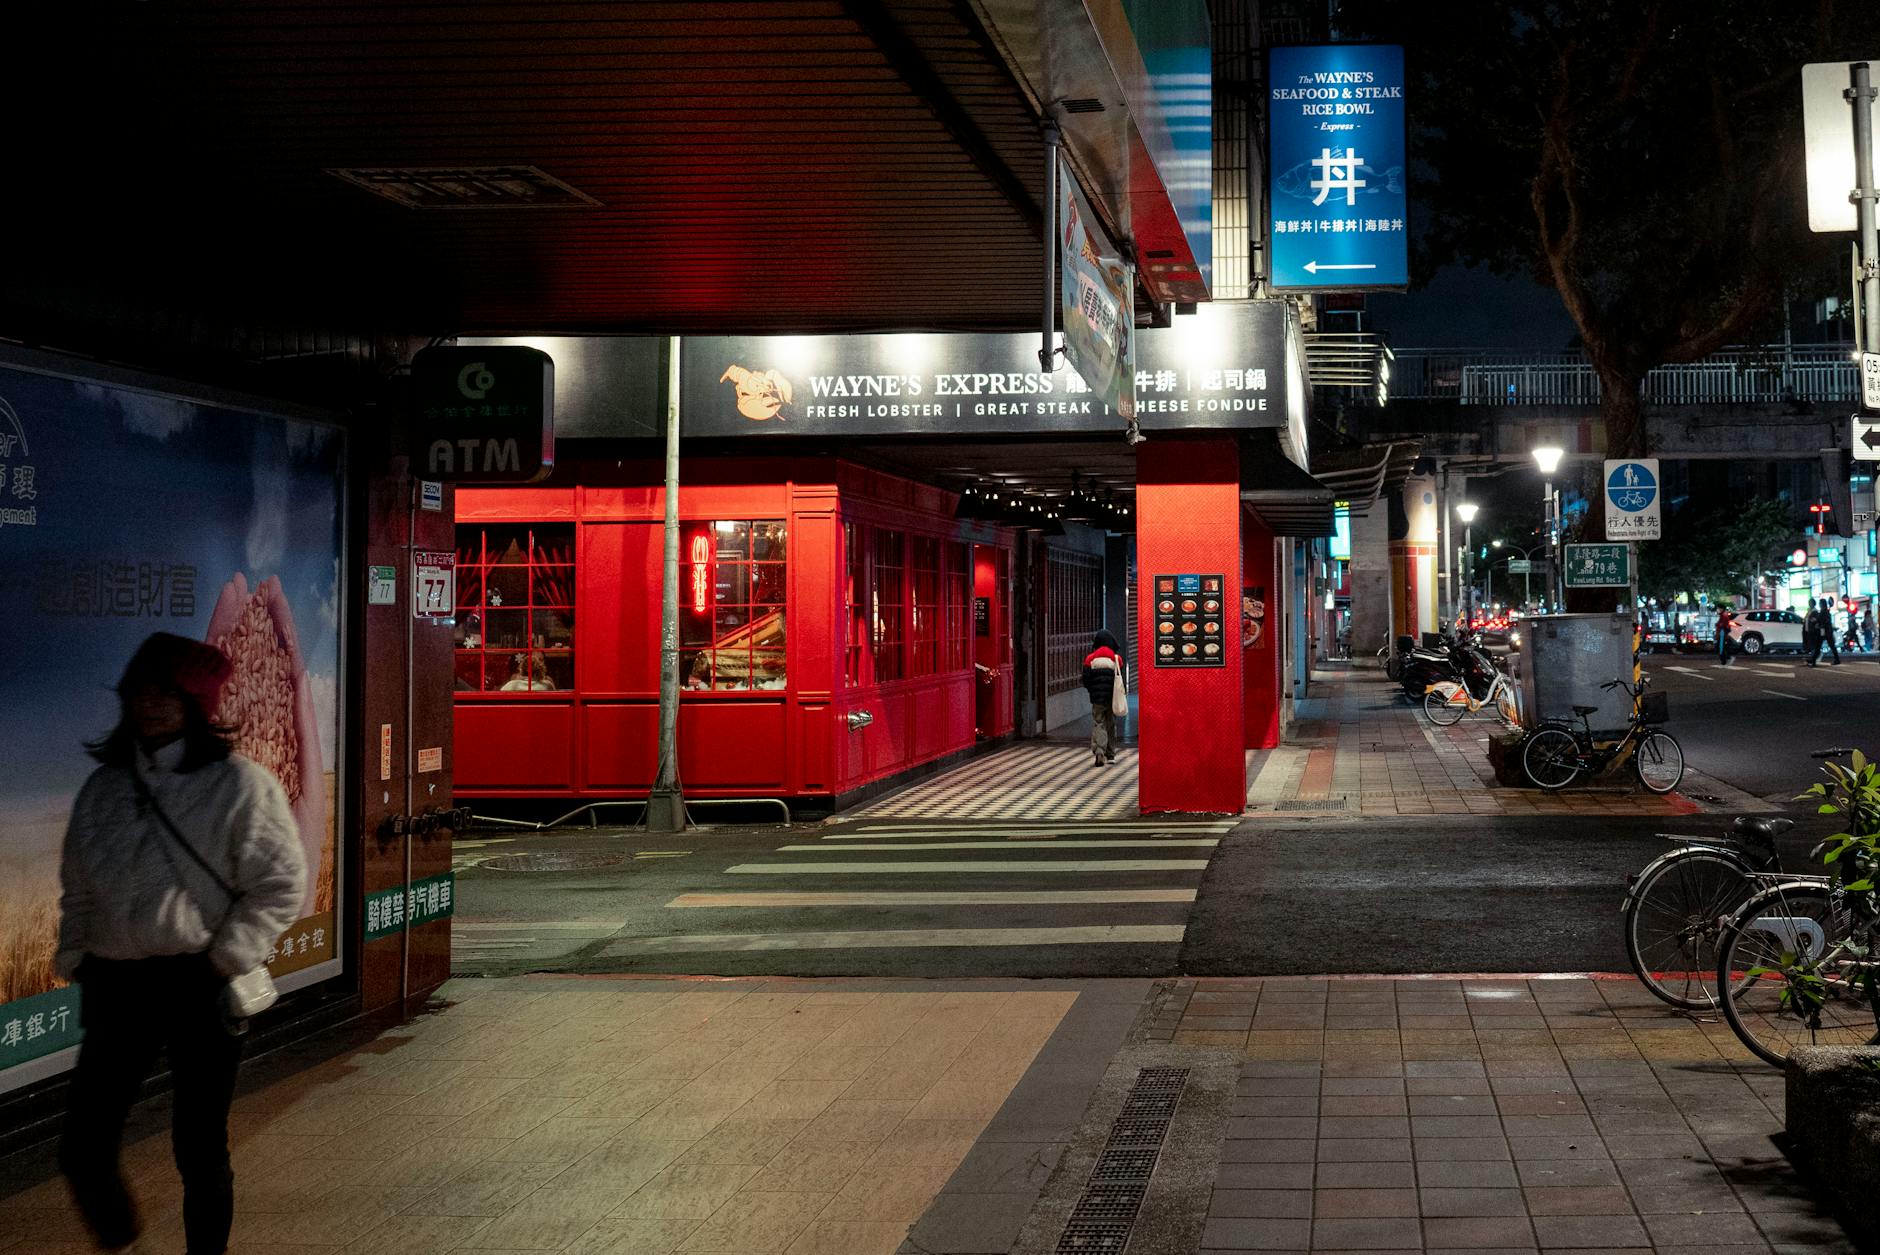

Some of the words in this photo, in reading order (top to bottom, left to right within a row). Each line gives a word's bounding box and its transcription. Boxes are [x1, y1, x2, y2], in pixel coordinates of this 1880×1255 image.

[1299, 75, 1313, 84] The
[1314, 72, 1374, 84] WAYNE'S
[1272, 88, 1339, 100] SEAFOOD
[1341, 88, 1352, 99] &
[1355, 87, 1402, 99] STEAK
[1302, 104, 1333, 116] RICE
[1336, 103, 1374, 115] BOWL
[1310, 147, 1367, 207] 丼
[808, 374, 922, 398] WAYNE'S
[934, 372, 1054, 396] EXPRESS
[1136, 370, 1177, 392] 牛排
[1201, 368, 1267, 391] 起司鍋
[806, 404, 860, 418] FRESH
[867, 403, 943, 417] LOBSTER
[974, 402, 1029, 416] GREAT
[1036, 401, 1091, 415] STEAK
[1136, 400, 1189, 413] HEESE
[1197, 399, 1267, 412] FONDUE
[428, 438, 521, 473] ATM
[1607, 515, 1659, 528] 行人優先
[380, 583, 391, 599] 77
[425, 579, 446, 608] 77
[0, 1005, 71, 1048] 庫銀行
